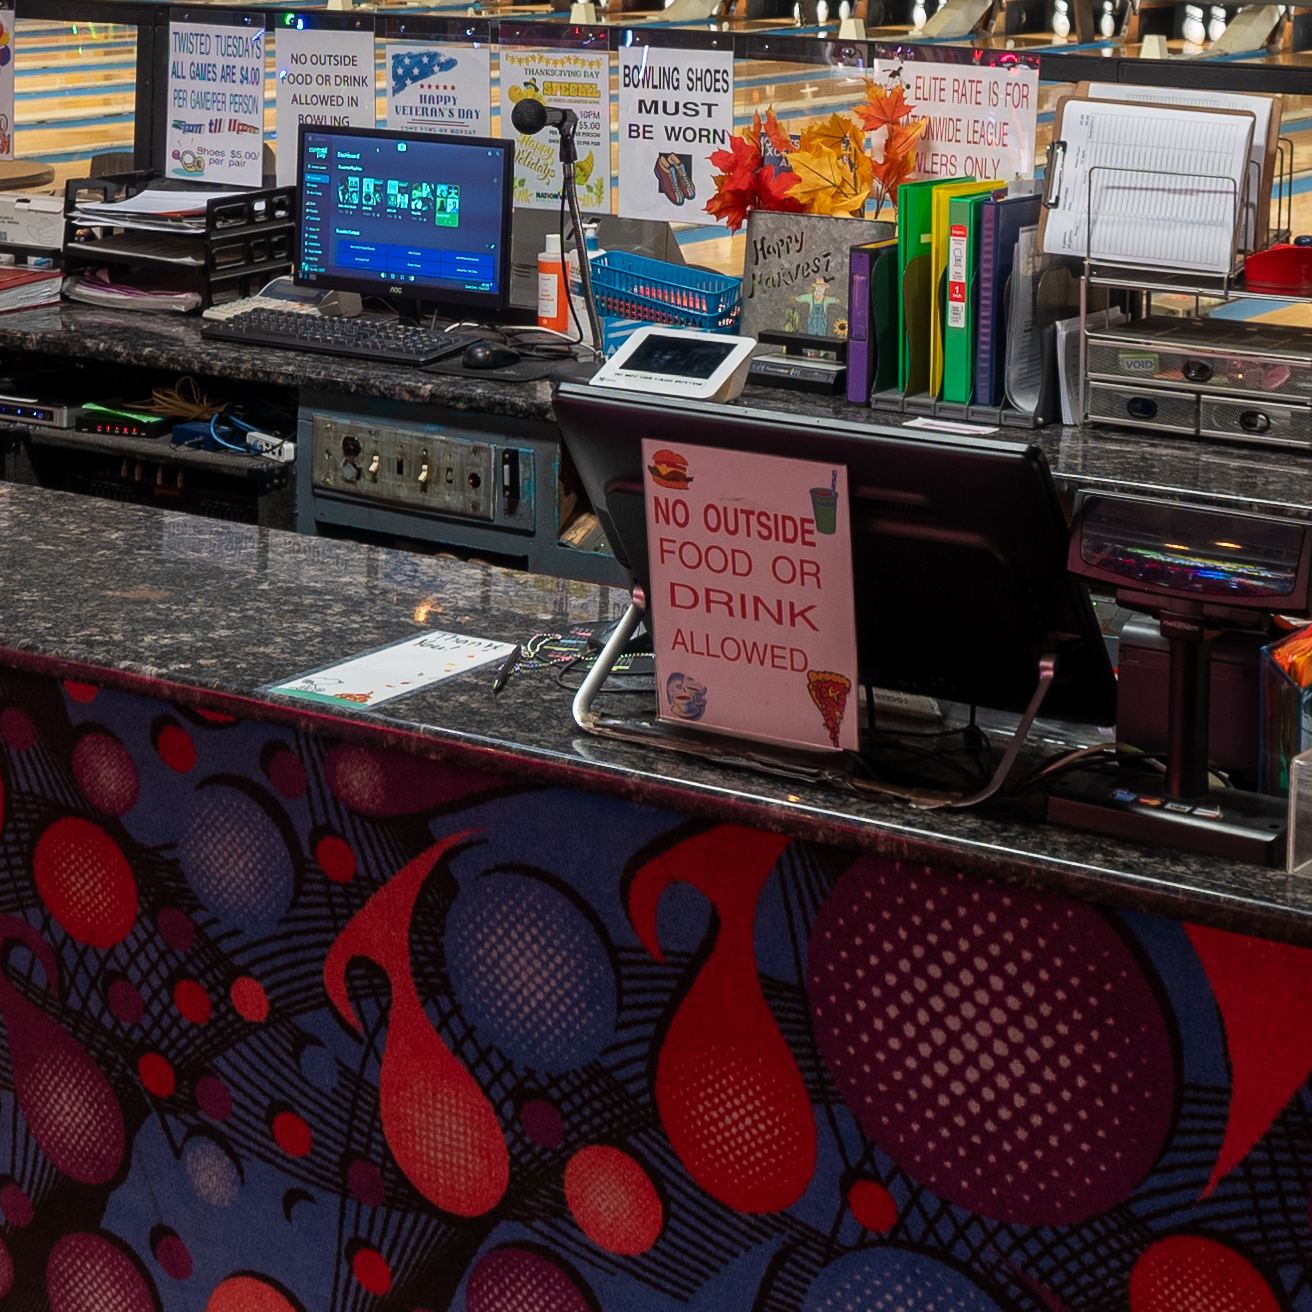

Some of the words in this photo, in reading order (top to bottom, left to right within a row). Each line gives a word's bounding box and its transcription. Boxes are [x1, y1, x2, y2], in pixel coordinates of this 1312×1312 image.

[173, 32, 211, 56] TWISTED
[216, 34, 262, 60] TUESDAYS
[171, 64, 186, 79] ALL
[190, 64, 216, 81] GAMES
[220, 65, 237, 83] ARE
[240, 66, 260, 86] $4.00
[623, 65, 680, 90] BOWLING
[687, 68, 729, 93] SHOES
[173, 89, 187, 107] PER
[190, 91, 226, 110] GAME/PER
[229, 94, 259, 114] PERSON
[915, 76, 946, 102] ELITE
[952, 78, 982, 105] RATE
[988, 81, 999, 107] IS
[1005, 82, 1029, 109] FOR
[638, 99, 718, 118] MUST
[628, 124, 653, 139] BE
[665, 125, 725, 144] WORN
[967, 119, 1009, 147] LEAGUE
[228, 159, 246, 167] pair
[755, 232, 804, 265] Happy
[654, 496, 690, 528] NO
[703, 503, 817, 547] OUTSIDE
[659, 537, 753, 577] FOOD
[772, 555, 822, 589] OR
[669, 582, 819, 632] DRINK
[671, 628, 809, 672] ALLOWED
